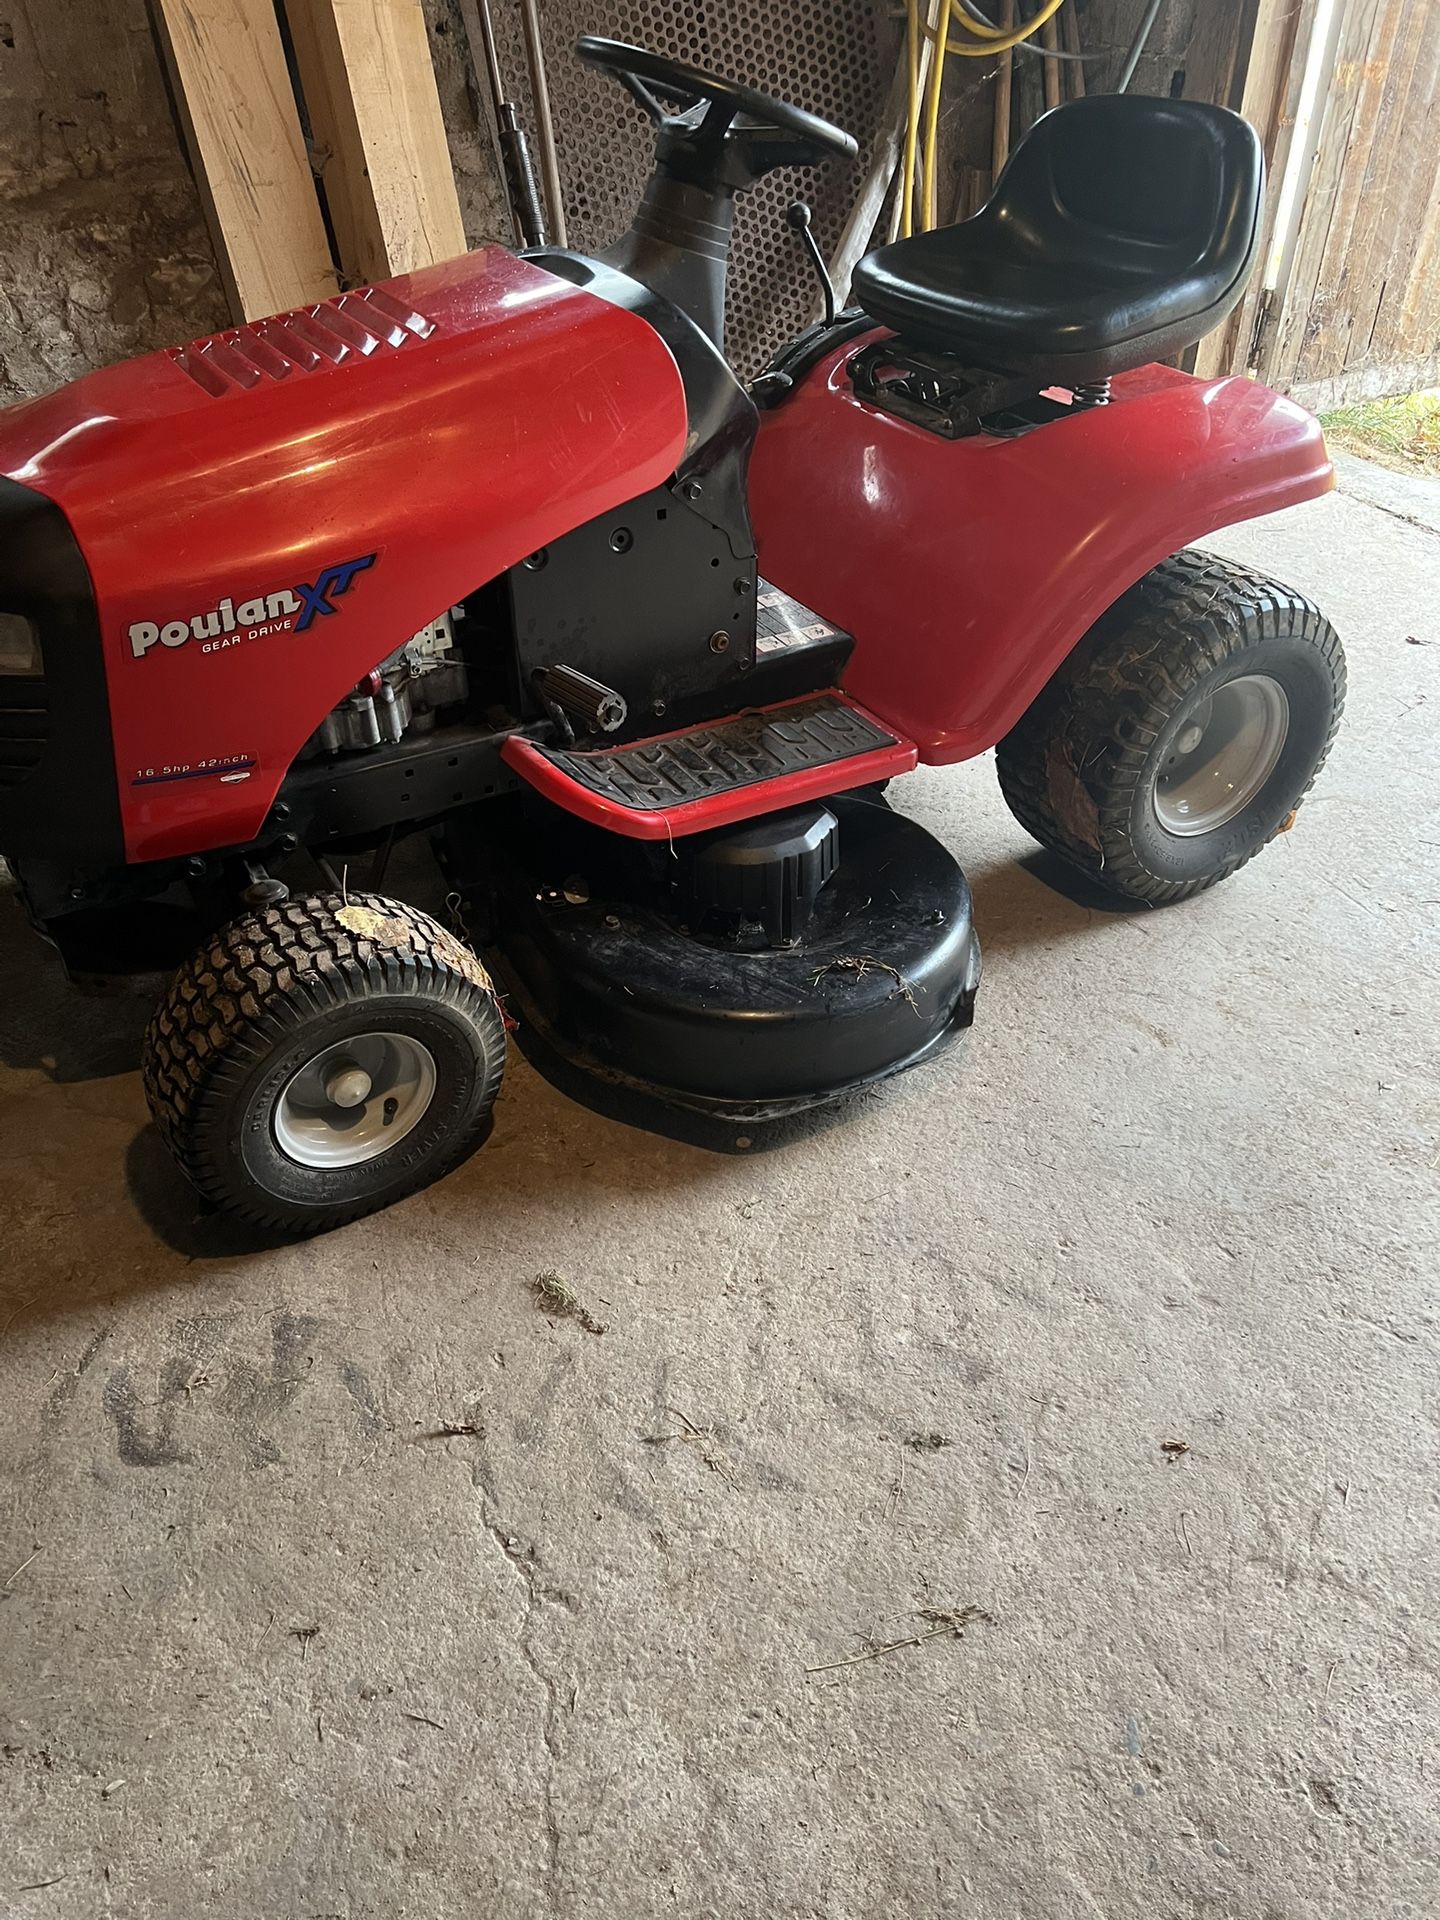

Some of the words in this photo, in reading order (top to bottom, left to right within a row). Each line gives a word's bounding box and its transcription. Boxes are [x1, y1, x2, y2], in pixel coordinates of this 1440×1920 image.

[293, 551, 378, 633] XT
[202, 635, 241, 654] GEAR
[248, 619, 293, 641] DRIVE
[197, 753, 249, 768] 42inch
